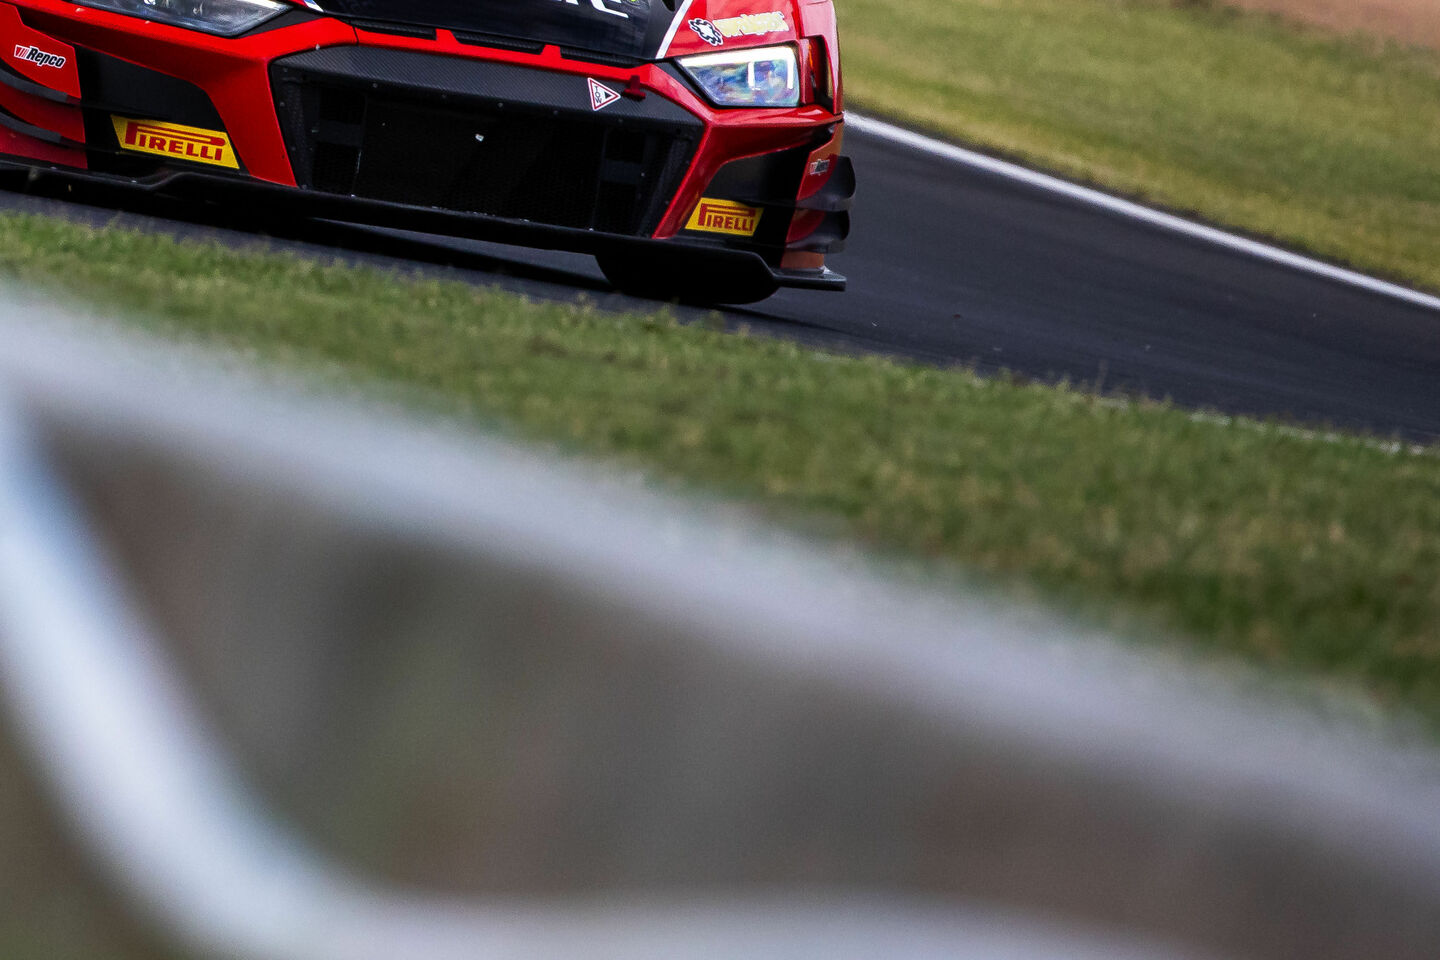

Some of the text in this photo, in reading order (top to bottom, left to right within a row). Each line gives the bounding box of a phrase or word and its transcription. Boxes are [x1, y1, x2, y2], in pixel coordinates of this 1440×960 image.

[26, 45, 66, 68] Repco
[594, 85, 603, 104] TOW
[124, 120, 227, 162] PIRELLI
[697, 202, 757, 232] PIRELLI
